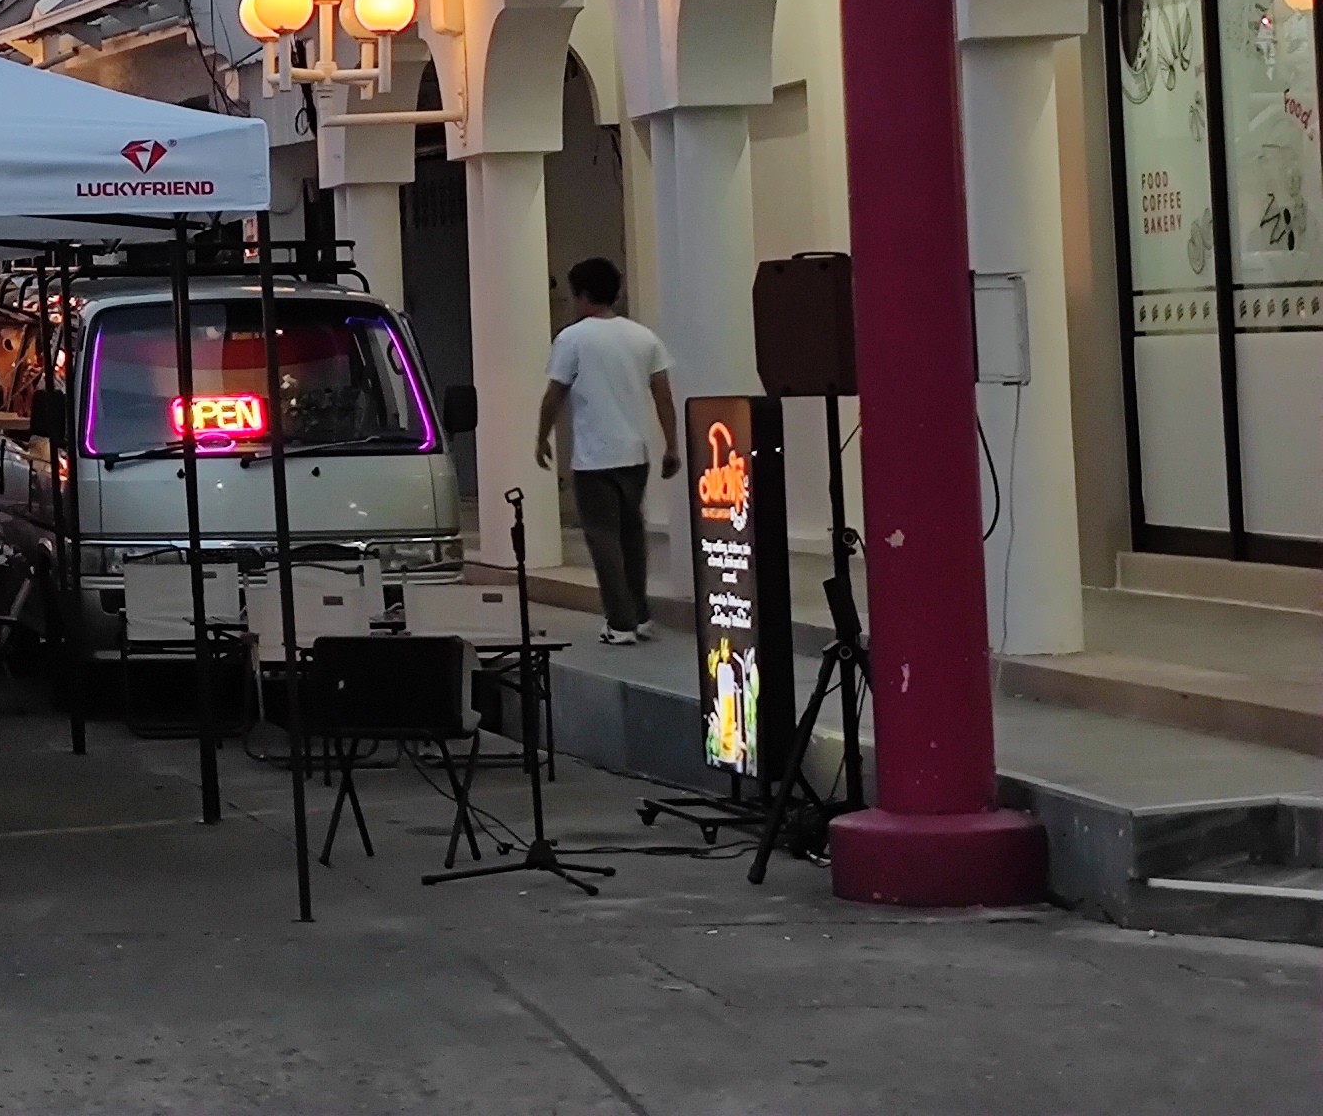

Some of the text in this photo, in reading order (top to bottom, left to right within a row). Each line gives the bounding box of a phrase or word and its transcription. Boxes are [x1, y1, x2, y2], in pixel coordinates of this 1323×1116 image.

[76, 181, 214, 197] LUCKYFRIEND
[1141, 171, 1168, 190] FOOD
[1142, 191, 1181, 213] COFFEE
[1143, 214, 1182, 235] BAKERY
